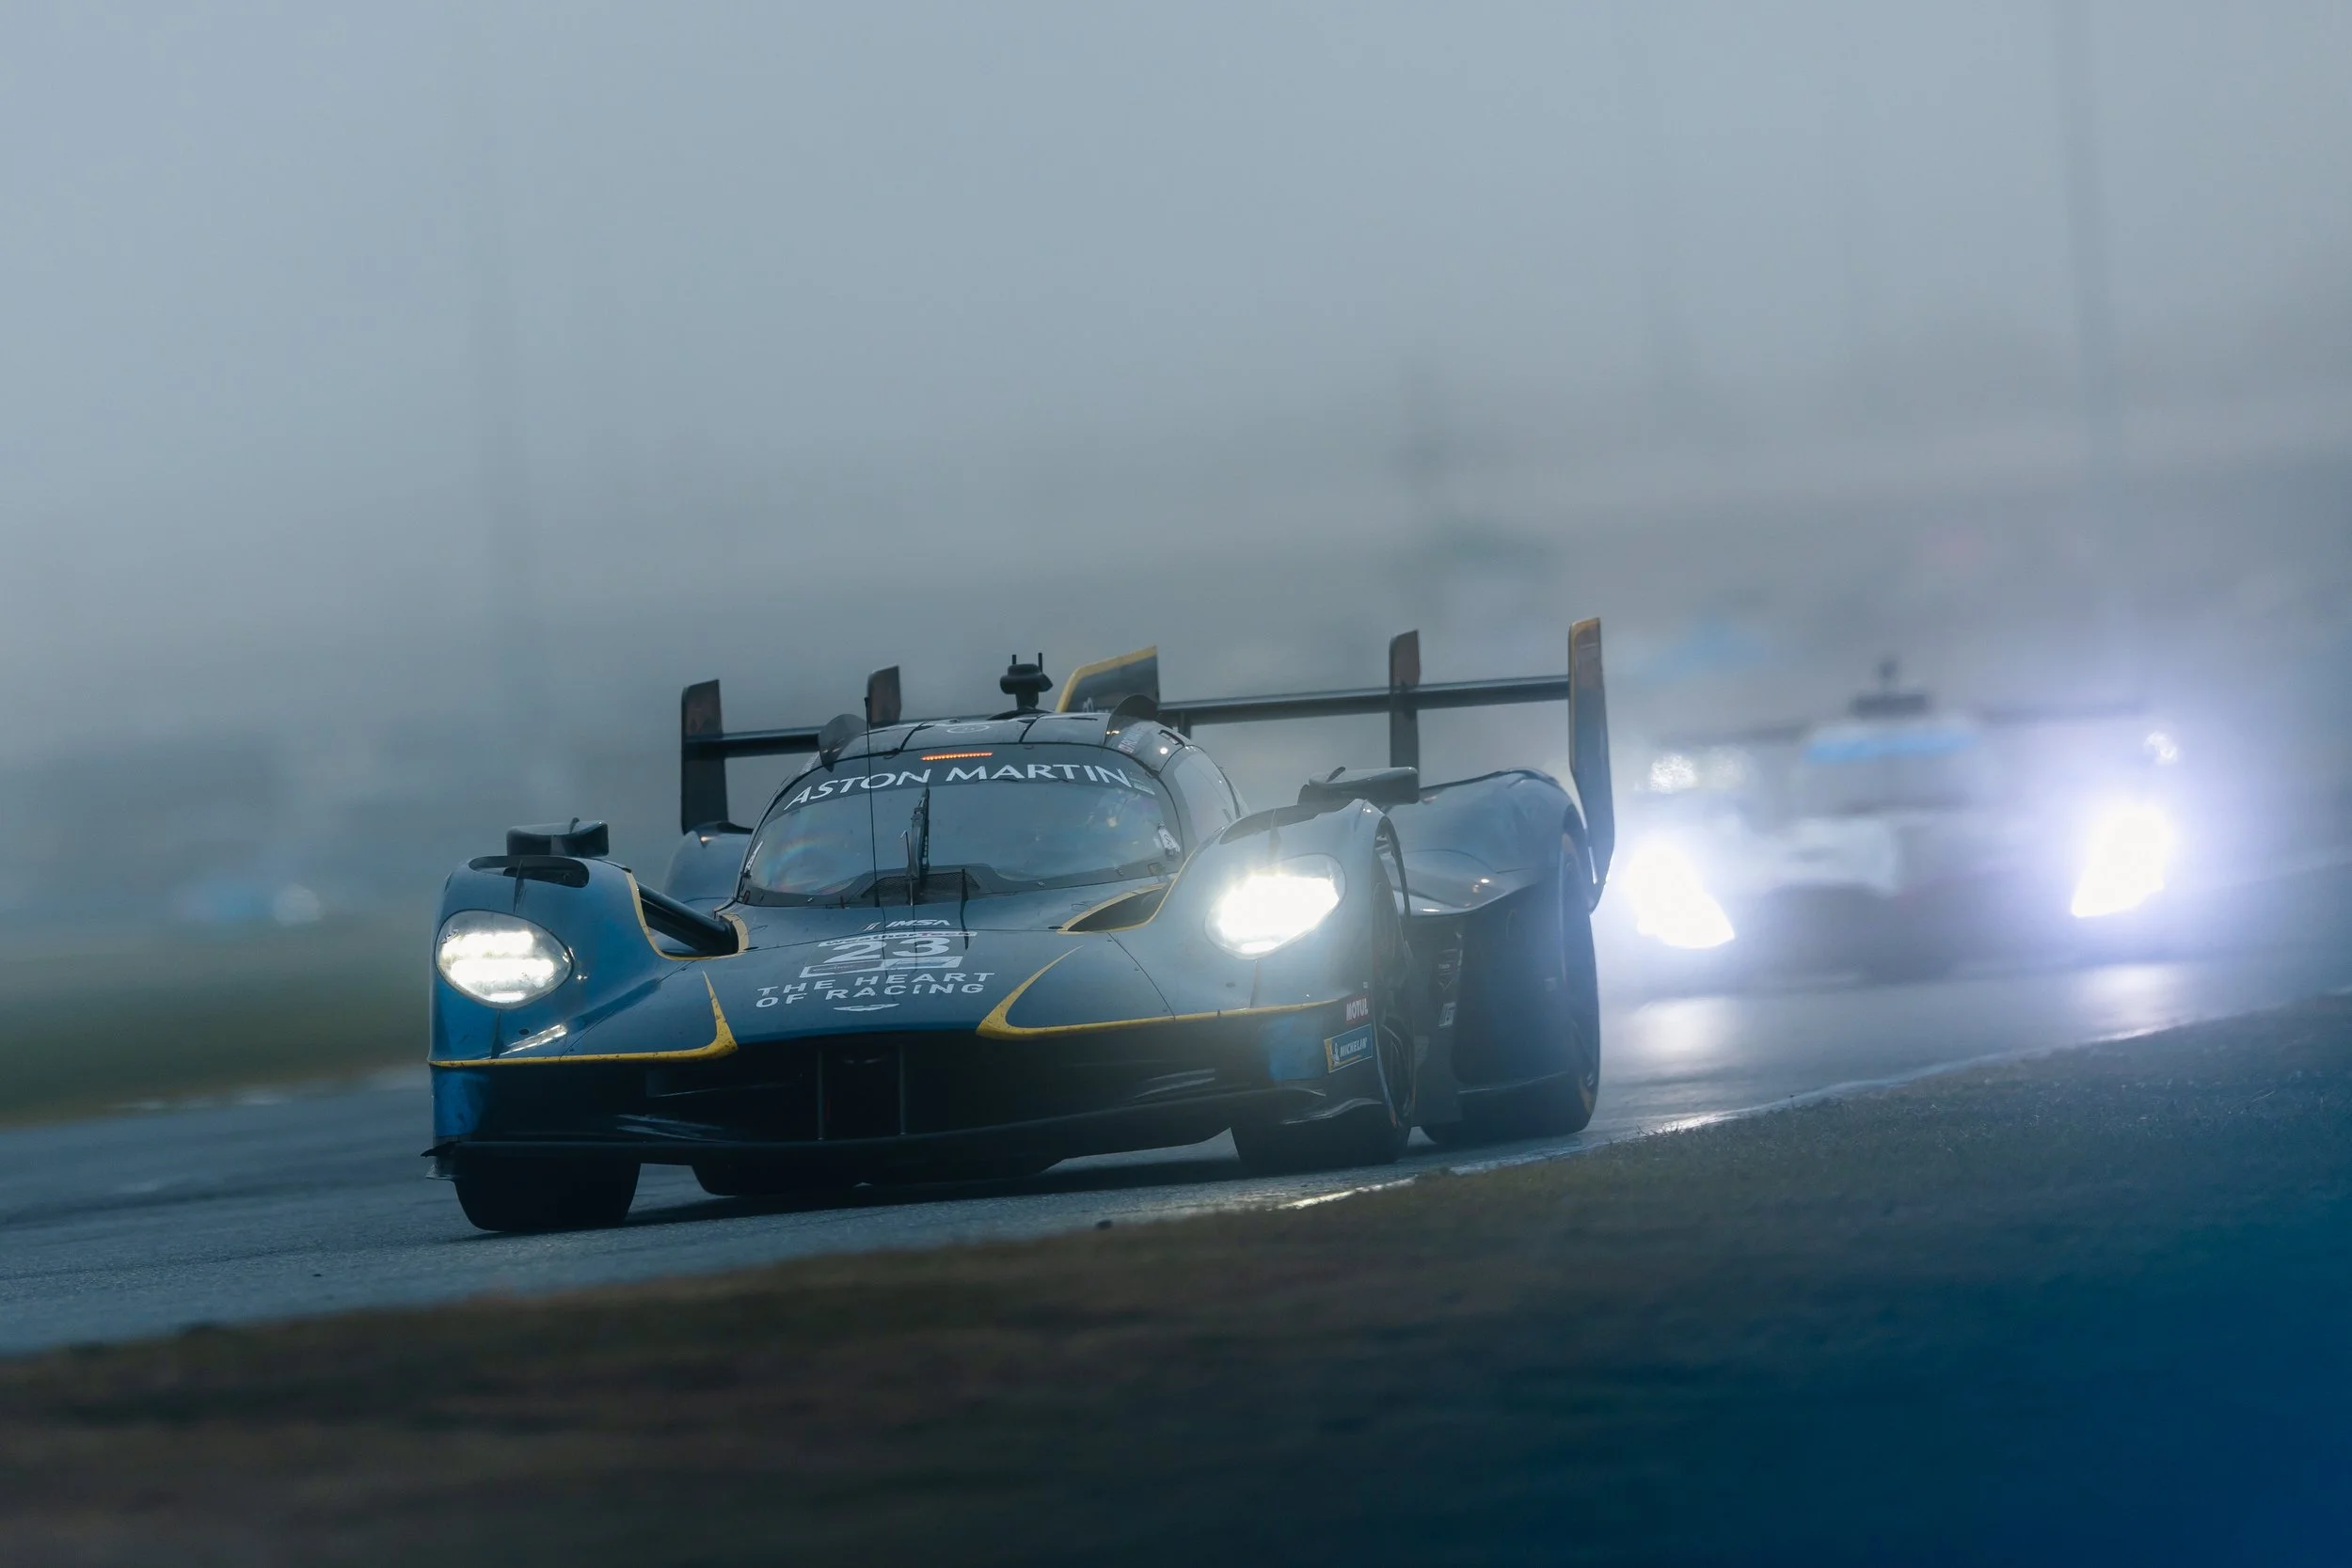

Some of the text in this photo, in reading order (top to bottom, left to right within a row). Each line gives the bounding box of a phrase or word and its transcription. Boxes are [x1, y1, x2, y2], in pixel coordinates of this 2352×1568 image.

[784, 763, 1133, 811] ASTON MARTIN
[885, 919, 950, 928] IMSA
[823, 937, 950, 964] 23
[755, 983, 986, 1009] OF RACING
[756, 973, 995, 997] THE HEART
[1345, 997, 1369, 1022] MOTUL
[1340, 1037, 1368, 1058] MICHELIN
